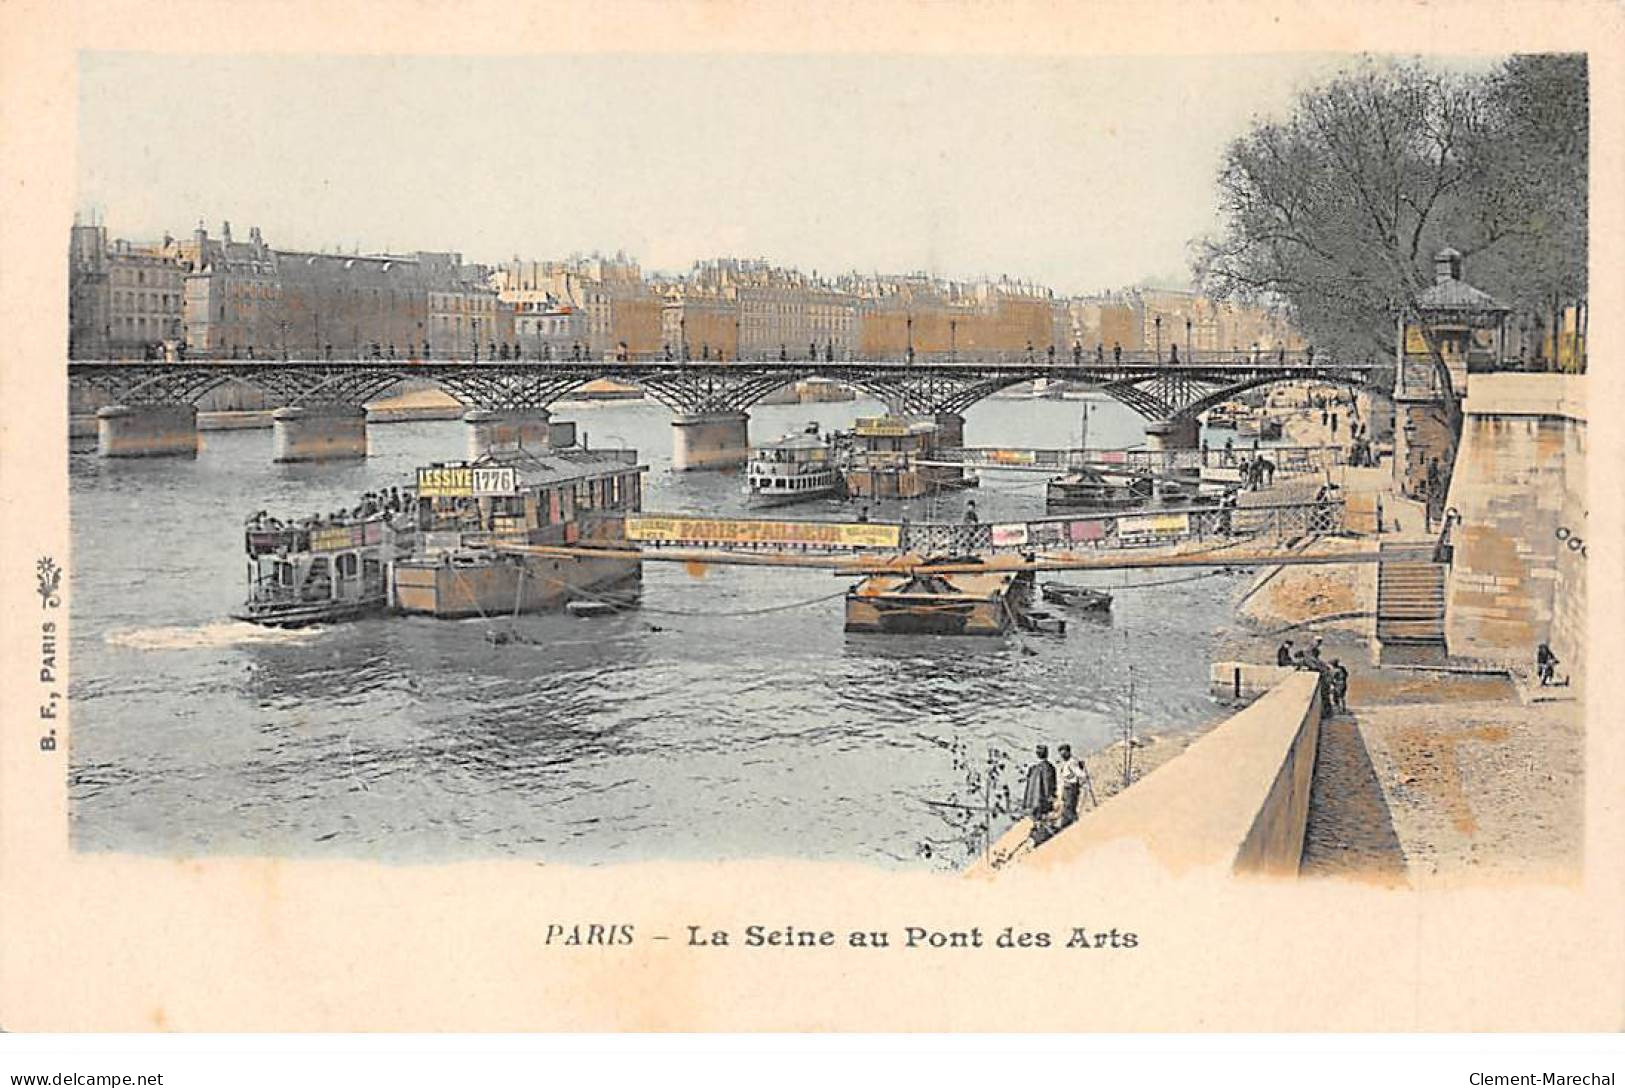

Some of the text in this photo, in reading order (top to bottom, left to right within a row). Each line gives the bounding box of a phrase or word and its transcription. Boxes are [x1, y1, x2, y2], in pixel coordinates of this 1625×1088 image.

[420, 468, 473, 487] LESSIVE
[475, 470, 512, 491] 1776
[40, 622, 56, 682] PARIS
[40, 728, 56, 751] B.
[545, 924, 635, 946] PARIS
[687, 925, 729, 946] La
[744, 925, 835, 947] Seine
[848, 931, 890, 948] au
[904, 926, 983, 948] Pont
[995, 926, 1052, 949] des
[1065, 927, 1139, 949] Arts
